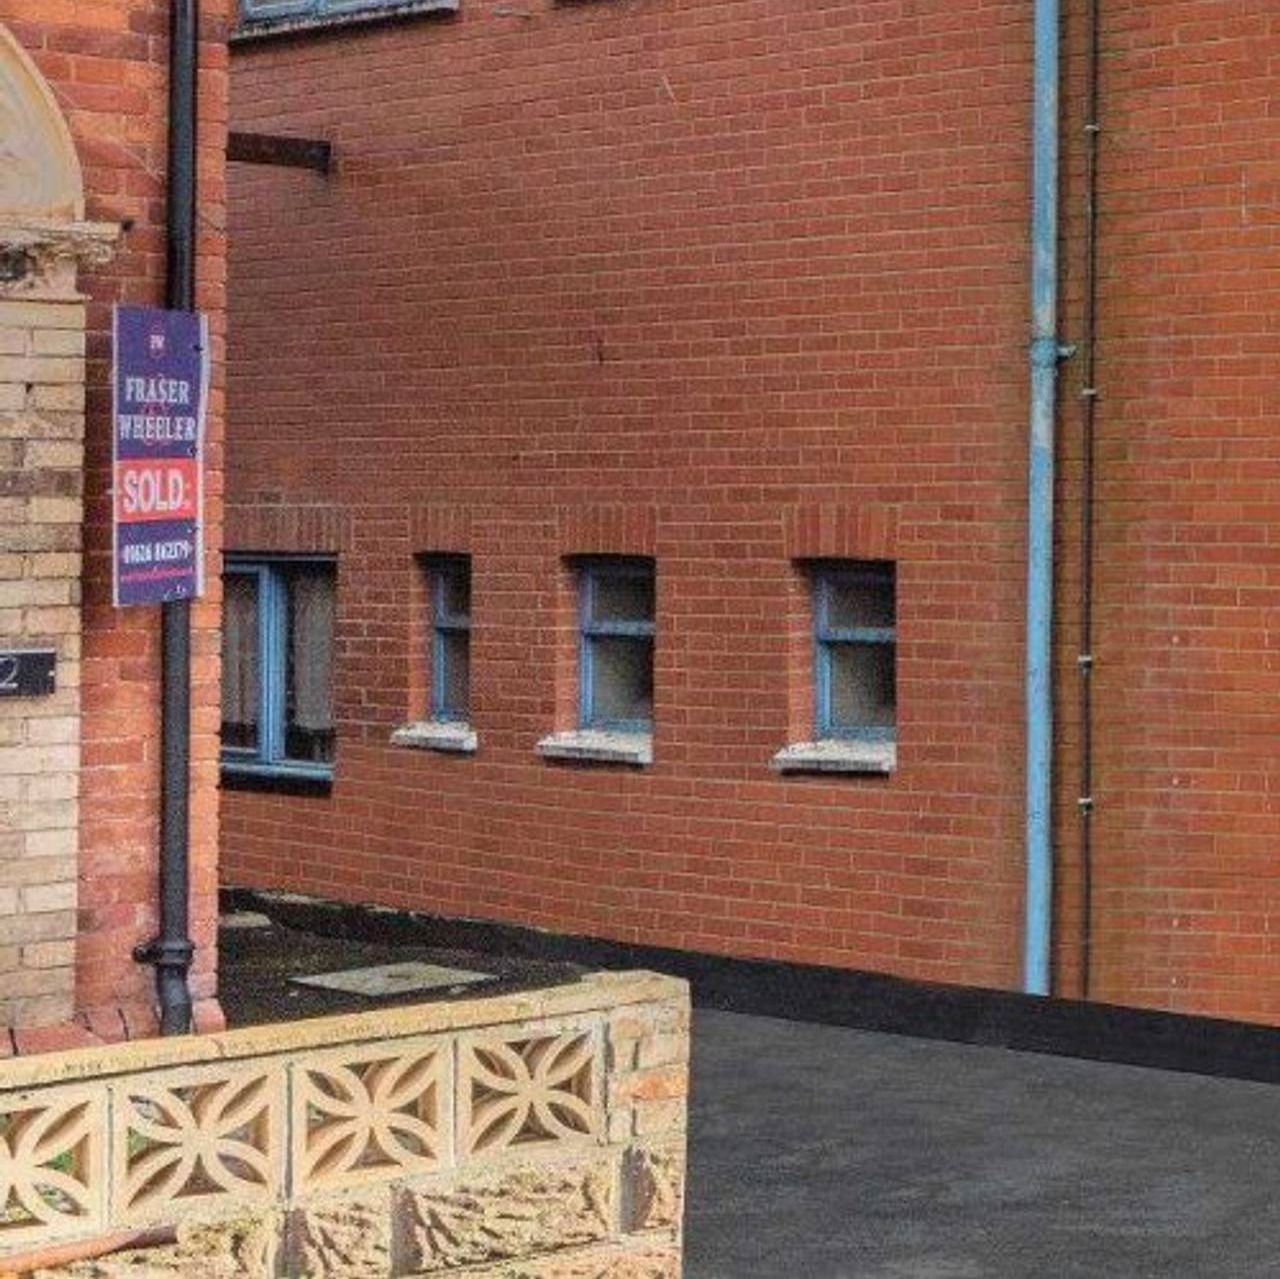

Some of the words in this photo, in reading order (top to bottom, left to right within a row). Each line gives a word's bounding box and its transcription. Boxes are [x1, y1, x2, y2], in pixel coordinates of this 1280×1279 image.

[125, 377, 190, 404] FRASER
[118, 414, 197, 441] WHEELER
[123, 469, 183, 513] SOLD
